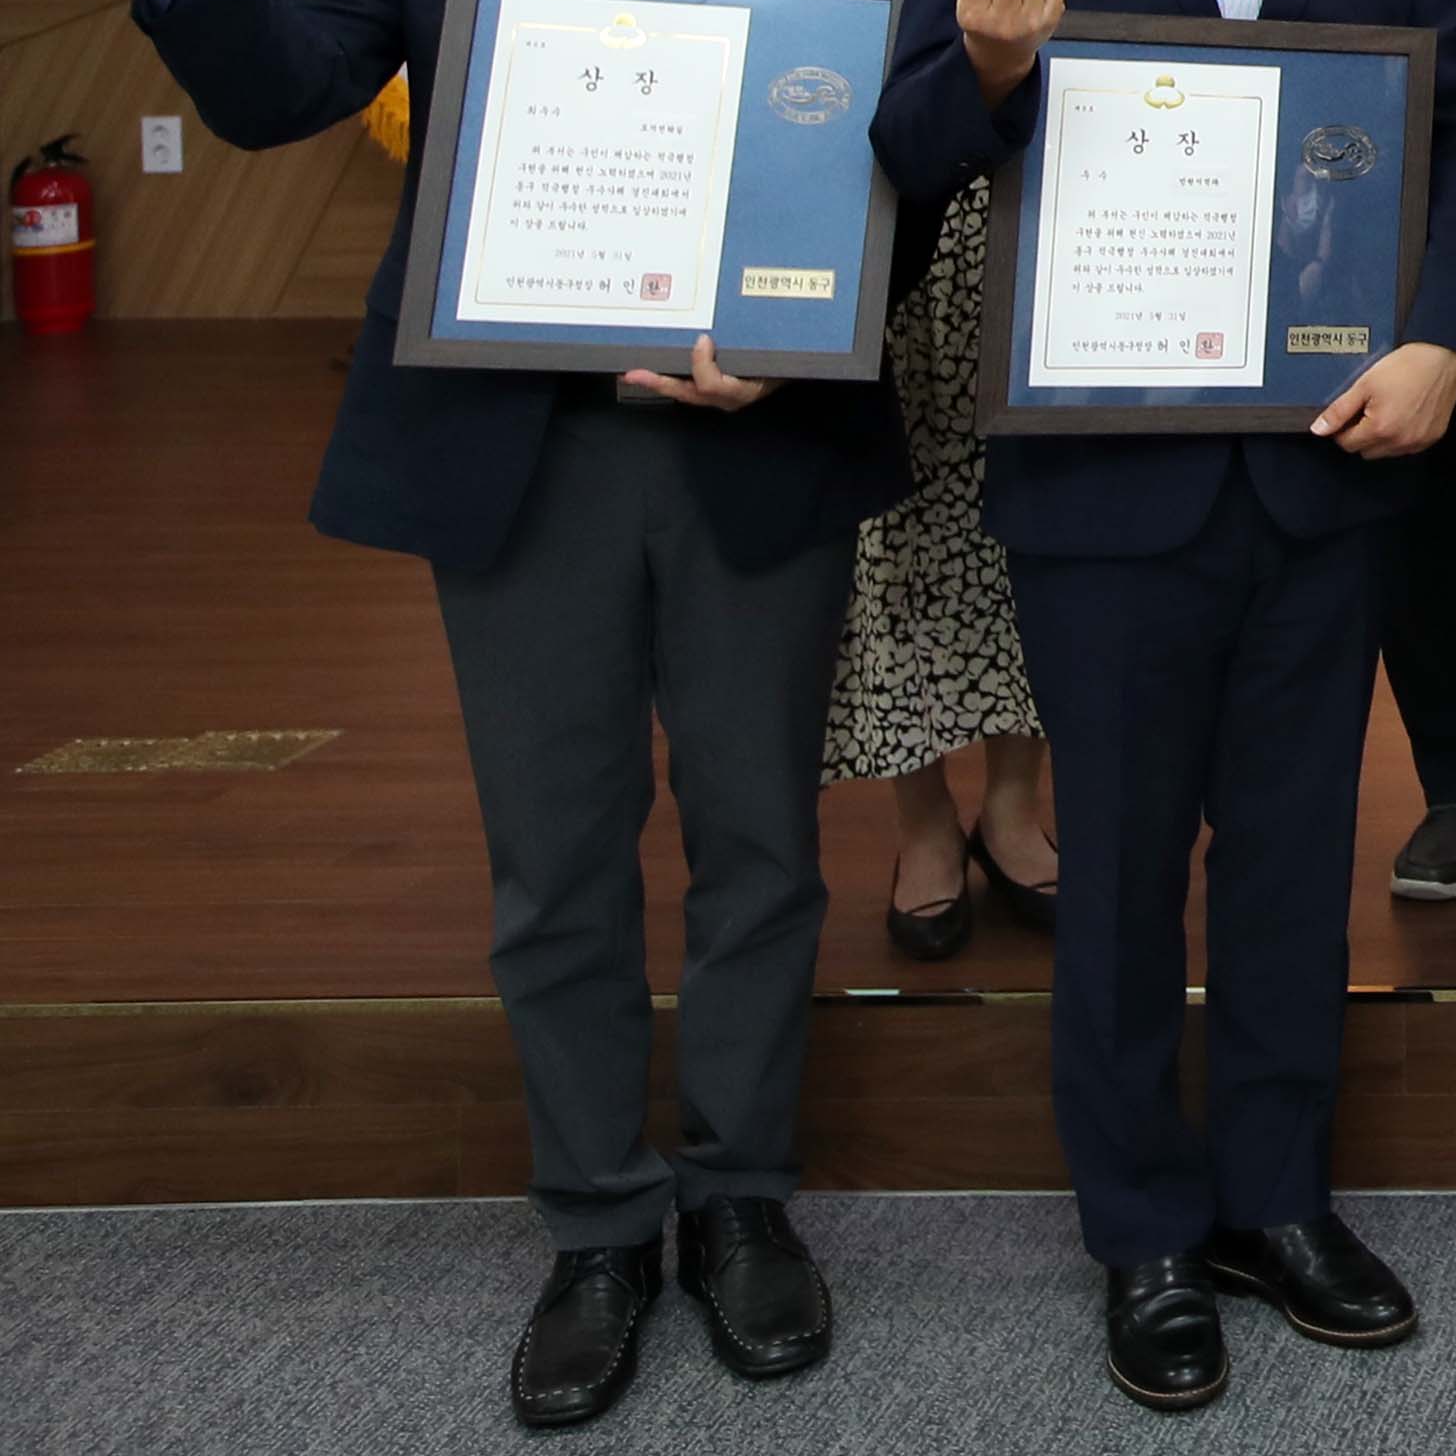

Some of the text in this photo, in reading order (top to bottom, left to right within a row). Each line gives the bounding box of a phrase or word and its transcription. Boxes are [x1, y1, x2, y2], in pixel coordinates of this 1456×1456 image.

[581, 66, 658, 96] 상 장
[1127, 128, 1200, 157] 상 장
[744, 274, 831, 292] 인천광역시 동구
[1289, 332, 1368, 347] 인천광역시 동구
